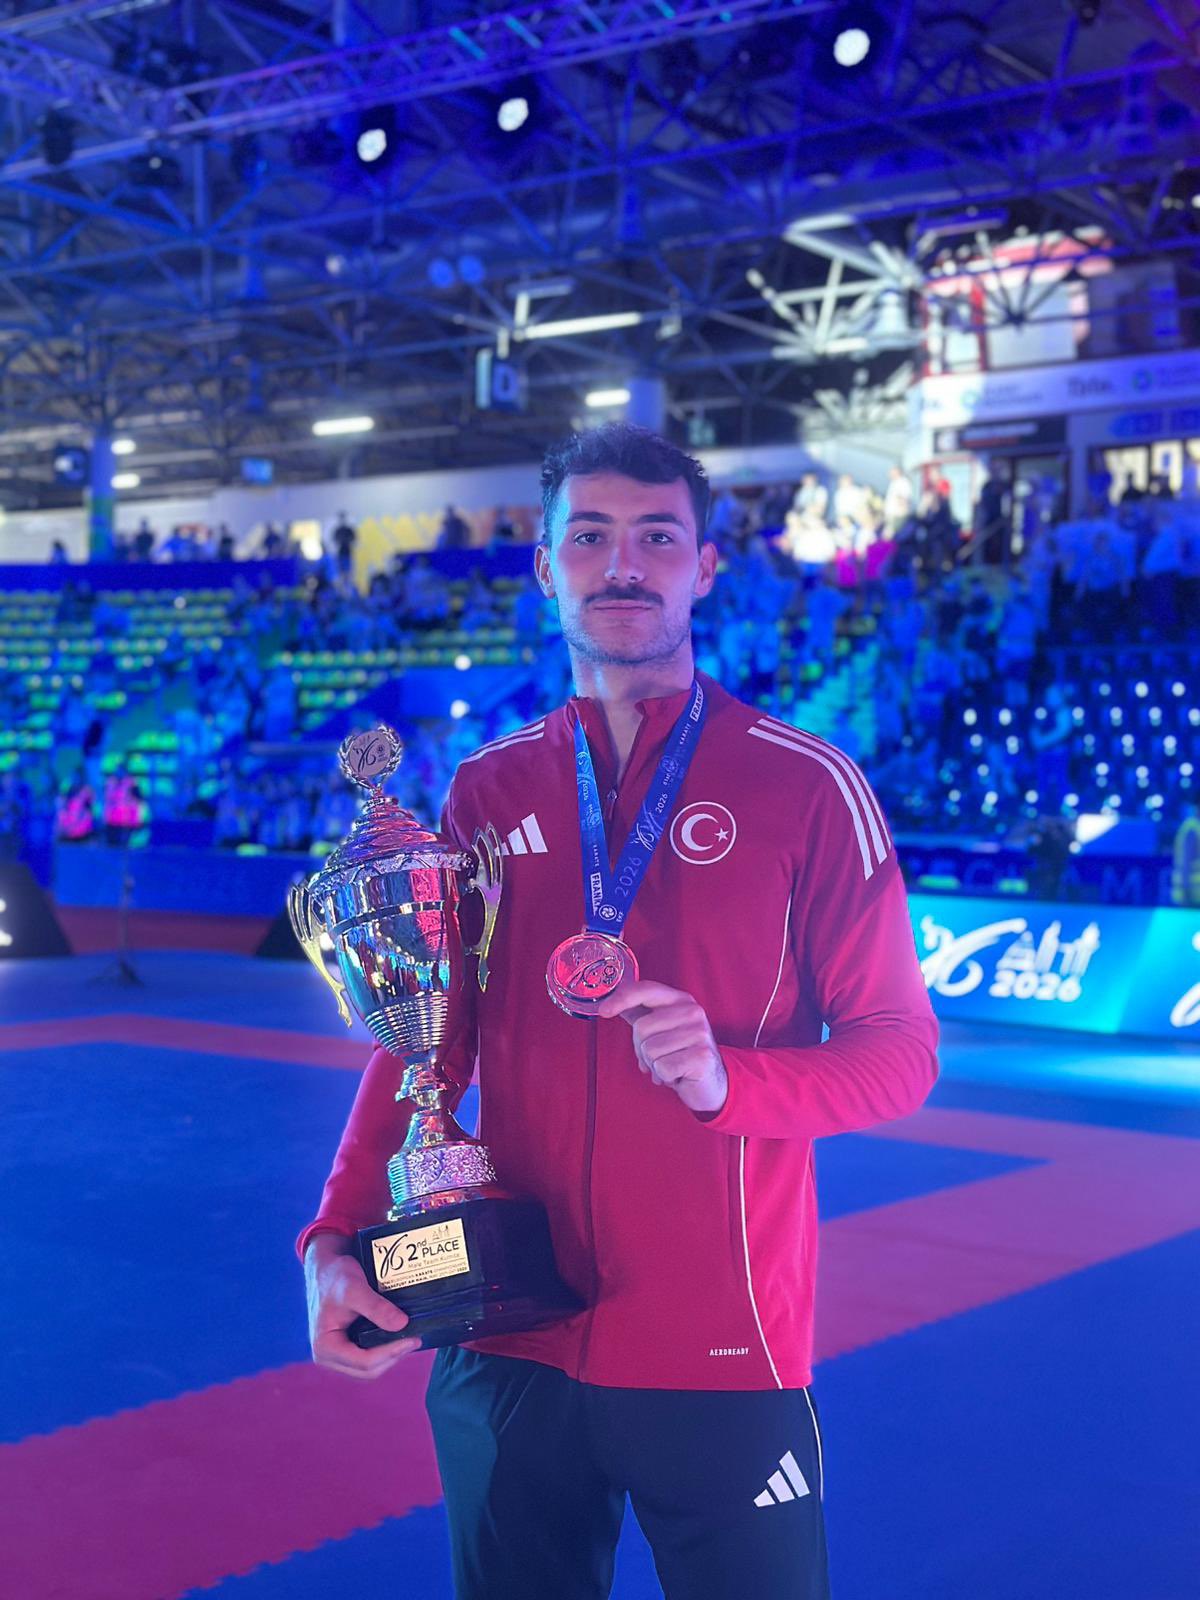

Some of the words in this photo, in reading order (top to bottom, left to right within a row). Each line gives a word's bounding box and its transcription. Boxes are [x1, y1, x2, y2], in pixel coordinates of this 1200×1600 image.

[655, 792, 668, 814] 2026
[614, 856, 642, 898] 2026
[989, 969, 1082, 1003] 2026
[406, 1239, 427, 1262] 2nd
[421, 1239, 460, 1259] PLACE
[709, 1347, 749, 1356] AEROREADY
